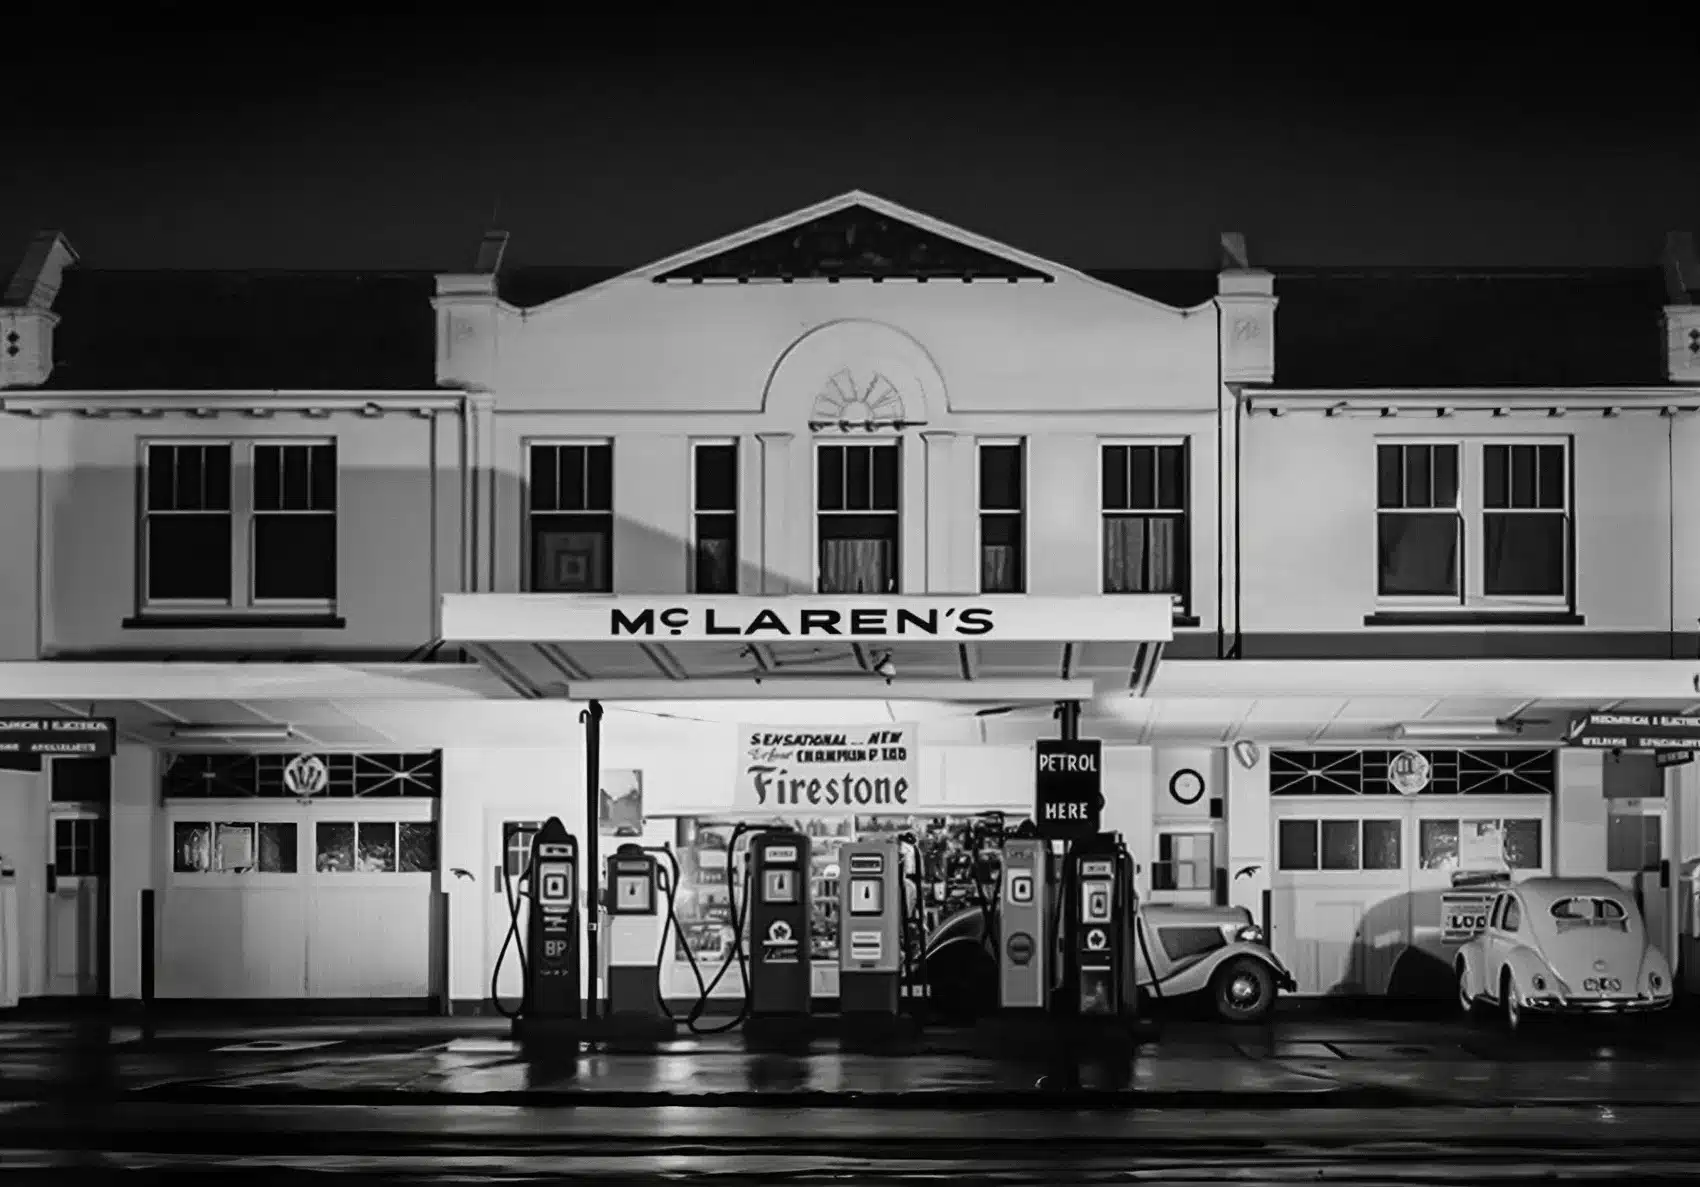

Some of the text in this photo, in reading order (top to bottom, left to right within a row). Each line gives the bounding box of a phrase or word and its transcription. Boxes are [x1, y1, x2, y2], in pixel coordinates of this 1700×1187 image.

[750, 731, 902, 746] SENSATIONAL NEW
[1039, 753, 1097, 772] PETROL
[748, 765, 909, 805] Firestone
[1045, 802, 1088, 819] HERE
[544, 940, 567, 956] BP
